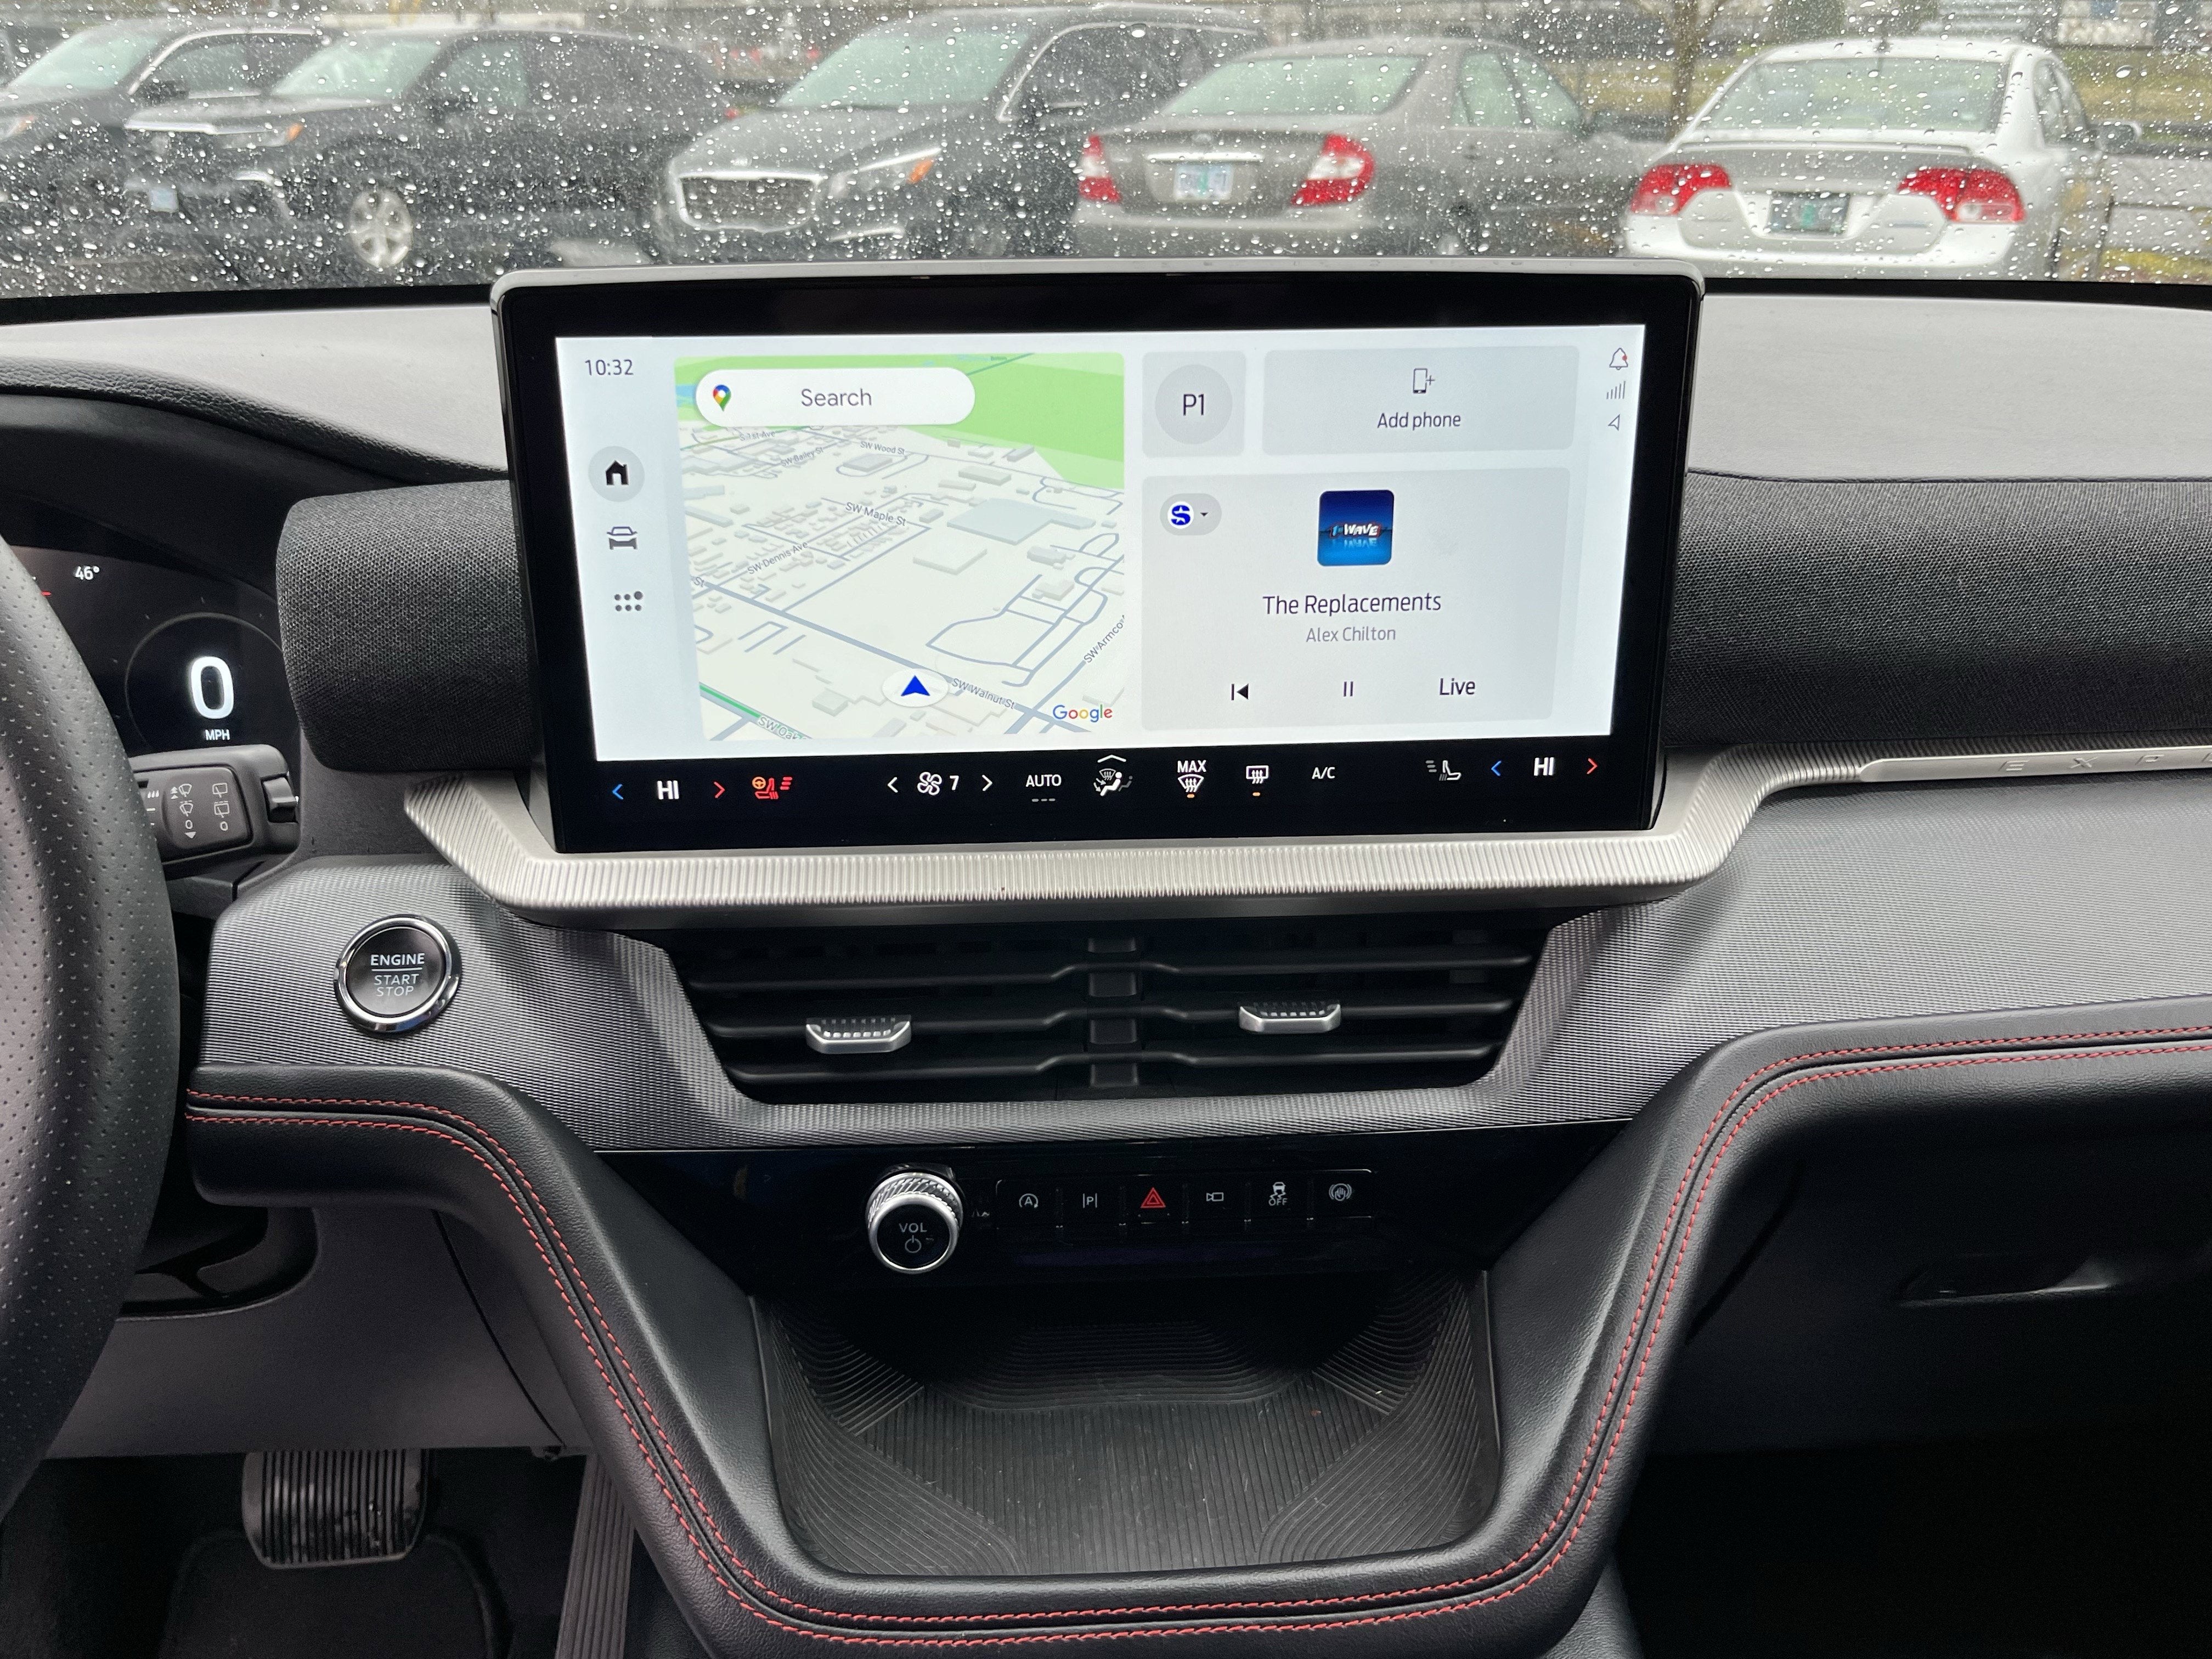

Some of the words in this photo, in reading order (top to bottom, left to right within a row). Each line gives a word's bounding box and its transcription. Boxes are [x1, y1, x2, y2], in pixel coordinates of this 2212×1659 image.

[585, 359, 634, 376] 10:32
[801, 388, 872, 407] Search
[1183, 394, 1204, 416] P1
[1377, 411, 1409, 428] Add
[1413, 411, 1461, 431] phone
[860, 441, 873, 450] SW
[874, 443, 895, 453] Wood
[781, 456, 794, 466] SW
[794, 450, 815, 462] Bailey
[815, 447, 824, 455] St
[845, 502, 862, 513] SW
[864, 508, 894, 522] Maple
[896, 516, 906, 527] St
[747, 562, 763, 574] SW
[763, 549, 792, 568] Dennis
[793, 541, 808, 554] Ave
[1262, 595, 1299, 614] The
[1305, 592, 1441, 617] Replacements
[1084, 647, 1098, 663] SW
[1097, 622, 1124, 651] Armco
[1306, 627, 1339, 642] Alex
[1342, 626, 1396, 641] Chilton
[190, 656, 234, 719] 0
[952, 678, 969, 690] SW
[970, 685, 1003, 704] Walnut
[1003, 698, 1015, 710] St
[1440, 678, 1476, 696] Live
[1053, 704, 1113, 723] Google
[758, 716, 776, 730] SW
[205, 729, 230, 741] MPH
[1177, 760, 1207, 772] MAX
[1312, 766, 1336, 780] A/C
[1533, 757, 1555, 776] HI
[949, 775, 960, 791] 7
[1025, 774, 1062, 787] AUTO
[657, 780, 680, 800] HI
[370, 952, 425, 966] ENGINE
[374, 973, 419, 986] START
[376, 986, 414, 997] STOP
[1268, 1197, 1288, 1206] OFF
[899, 1222, 928, 1233] VOL
